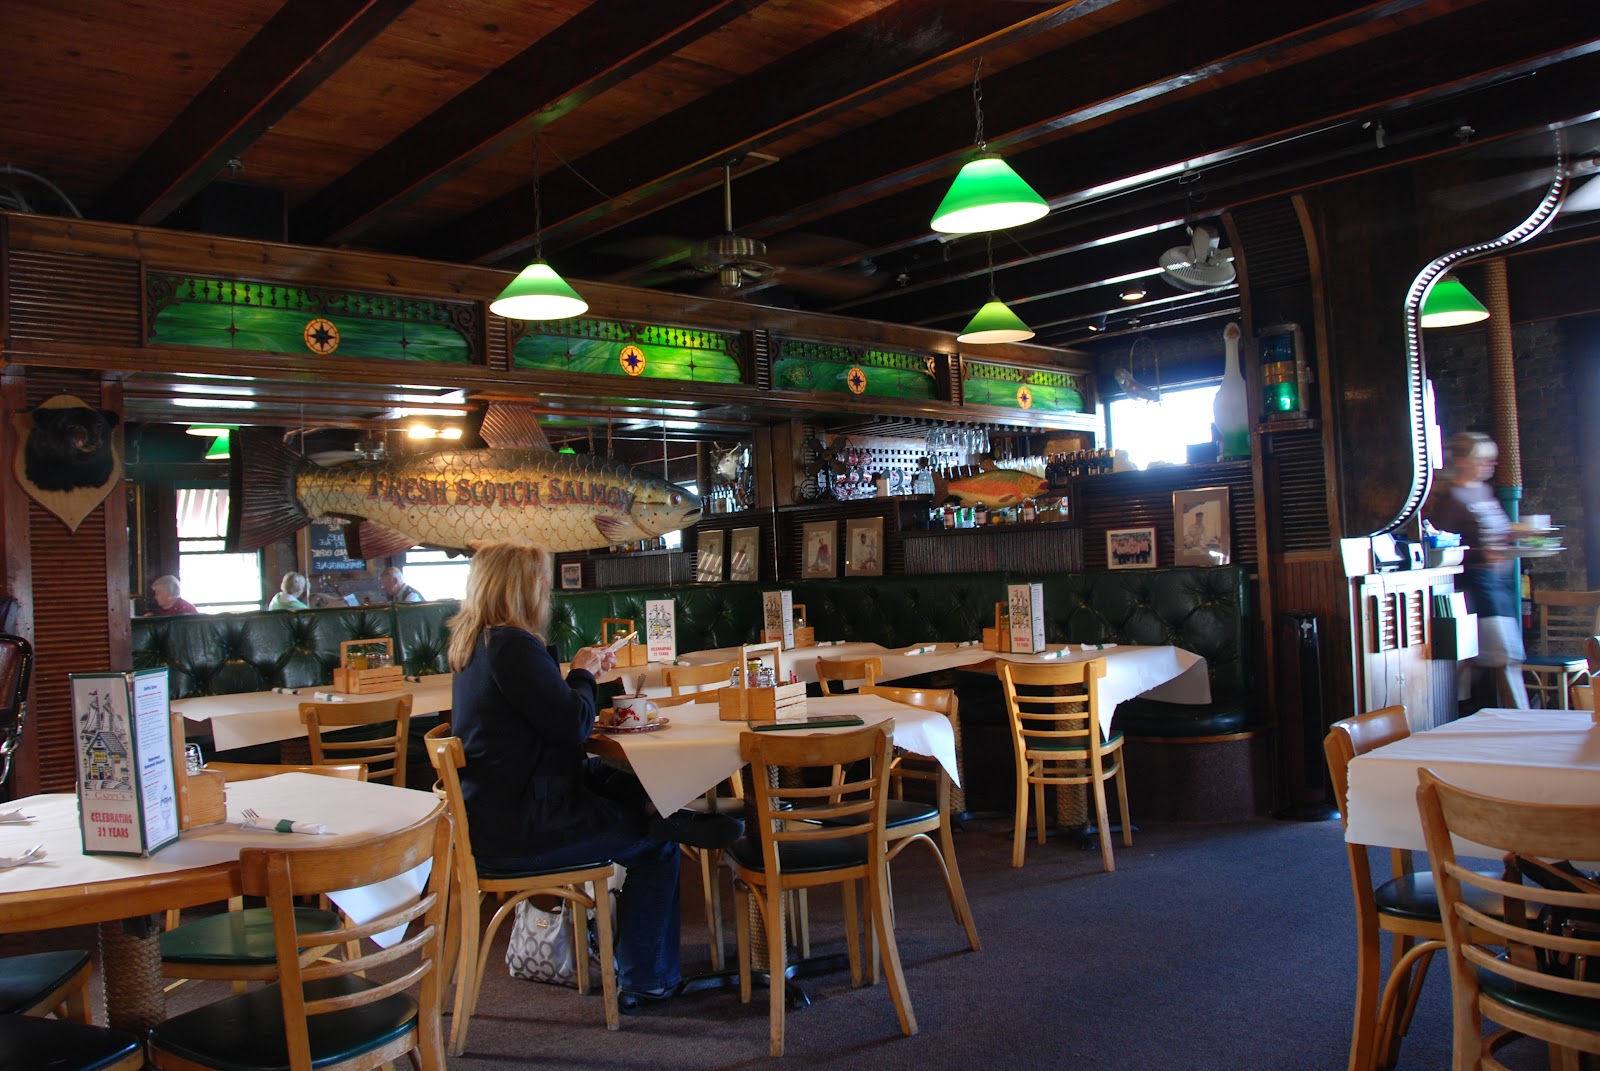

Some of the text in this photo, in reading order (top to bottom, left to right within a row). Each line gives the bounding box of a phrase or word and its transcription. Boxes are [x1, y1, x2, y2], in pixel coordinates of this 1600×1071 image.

[367, 471, 638, 515] FRESH SCOTCH SALMON
[90, 812, 133, 824] CELEBRATING
[108, 827, 129, 838] YEARS
